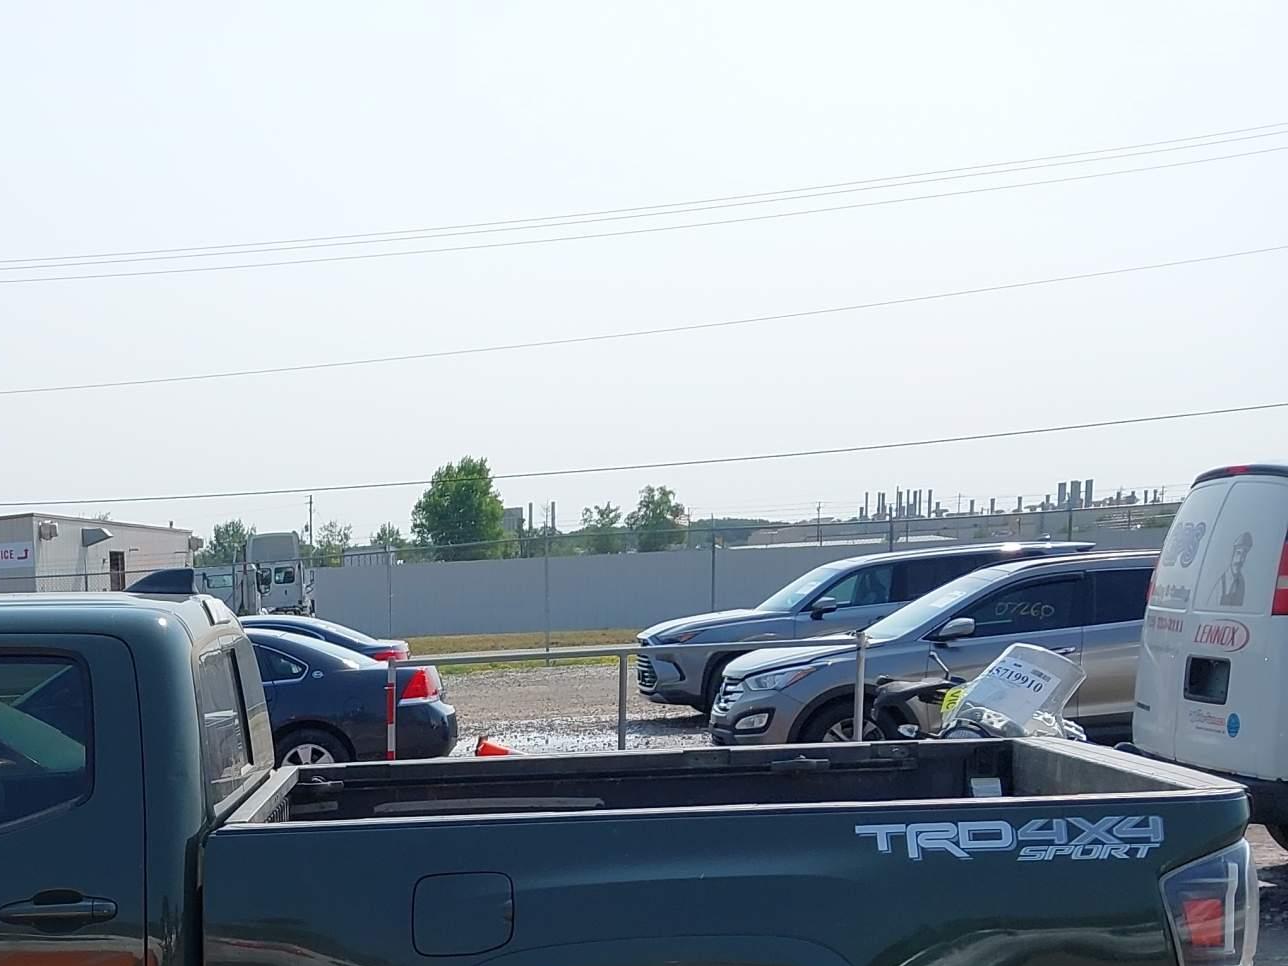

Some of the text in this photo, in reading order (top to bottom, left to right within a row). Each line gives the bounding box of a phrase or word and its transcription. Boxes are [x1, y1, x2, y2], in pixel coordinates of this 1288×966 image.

[1192, 623, 1240, 647] LENNOX
[855, 815, 1164, 860] TRD 4X4
[1016, 843, 1160, 861] SPORT
